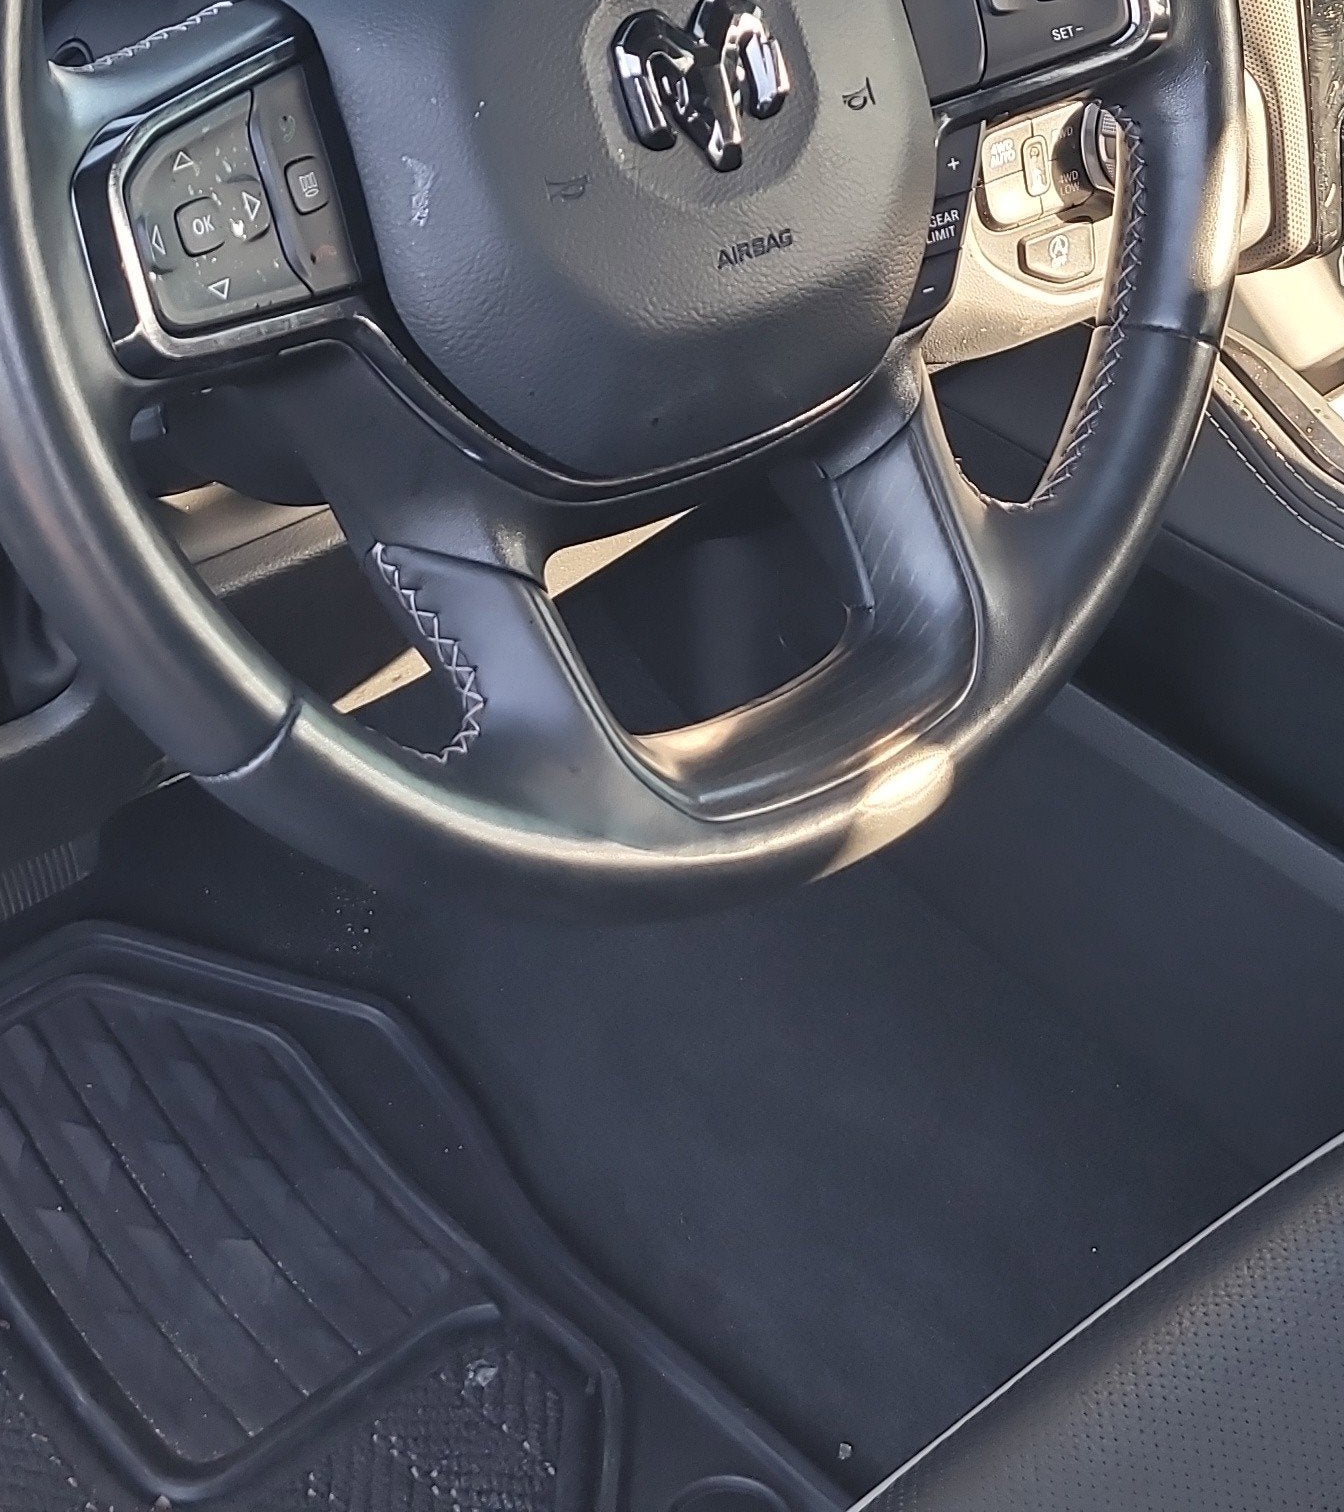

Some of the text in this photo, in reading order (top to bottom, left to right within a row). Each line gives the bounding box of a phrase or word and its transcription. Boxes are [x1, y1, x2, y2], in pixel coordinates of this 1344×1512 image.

[1059, 170, 1079, 185] 4WD
[1060, 181, 1080, 196] LOW
[192, 215, 215, 236] OK
[928, 209, 960, 228] GEAR
[925, 225, 956, 245] LIMIT
[717, 227, 794, 271] AIRBAG
